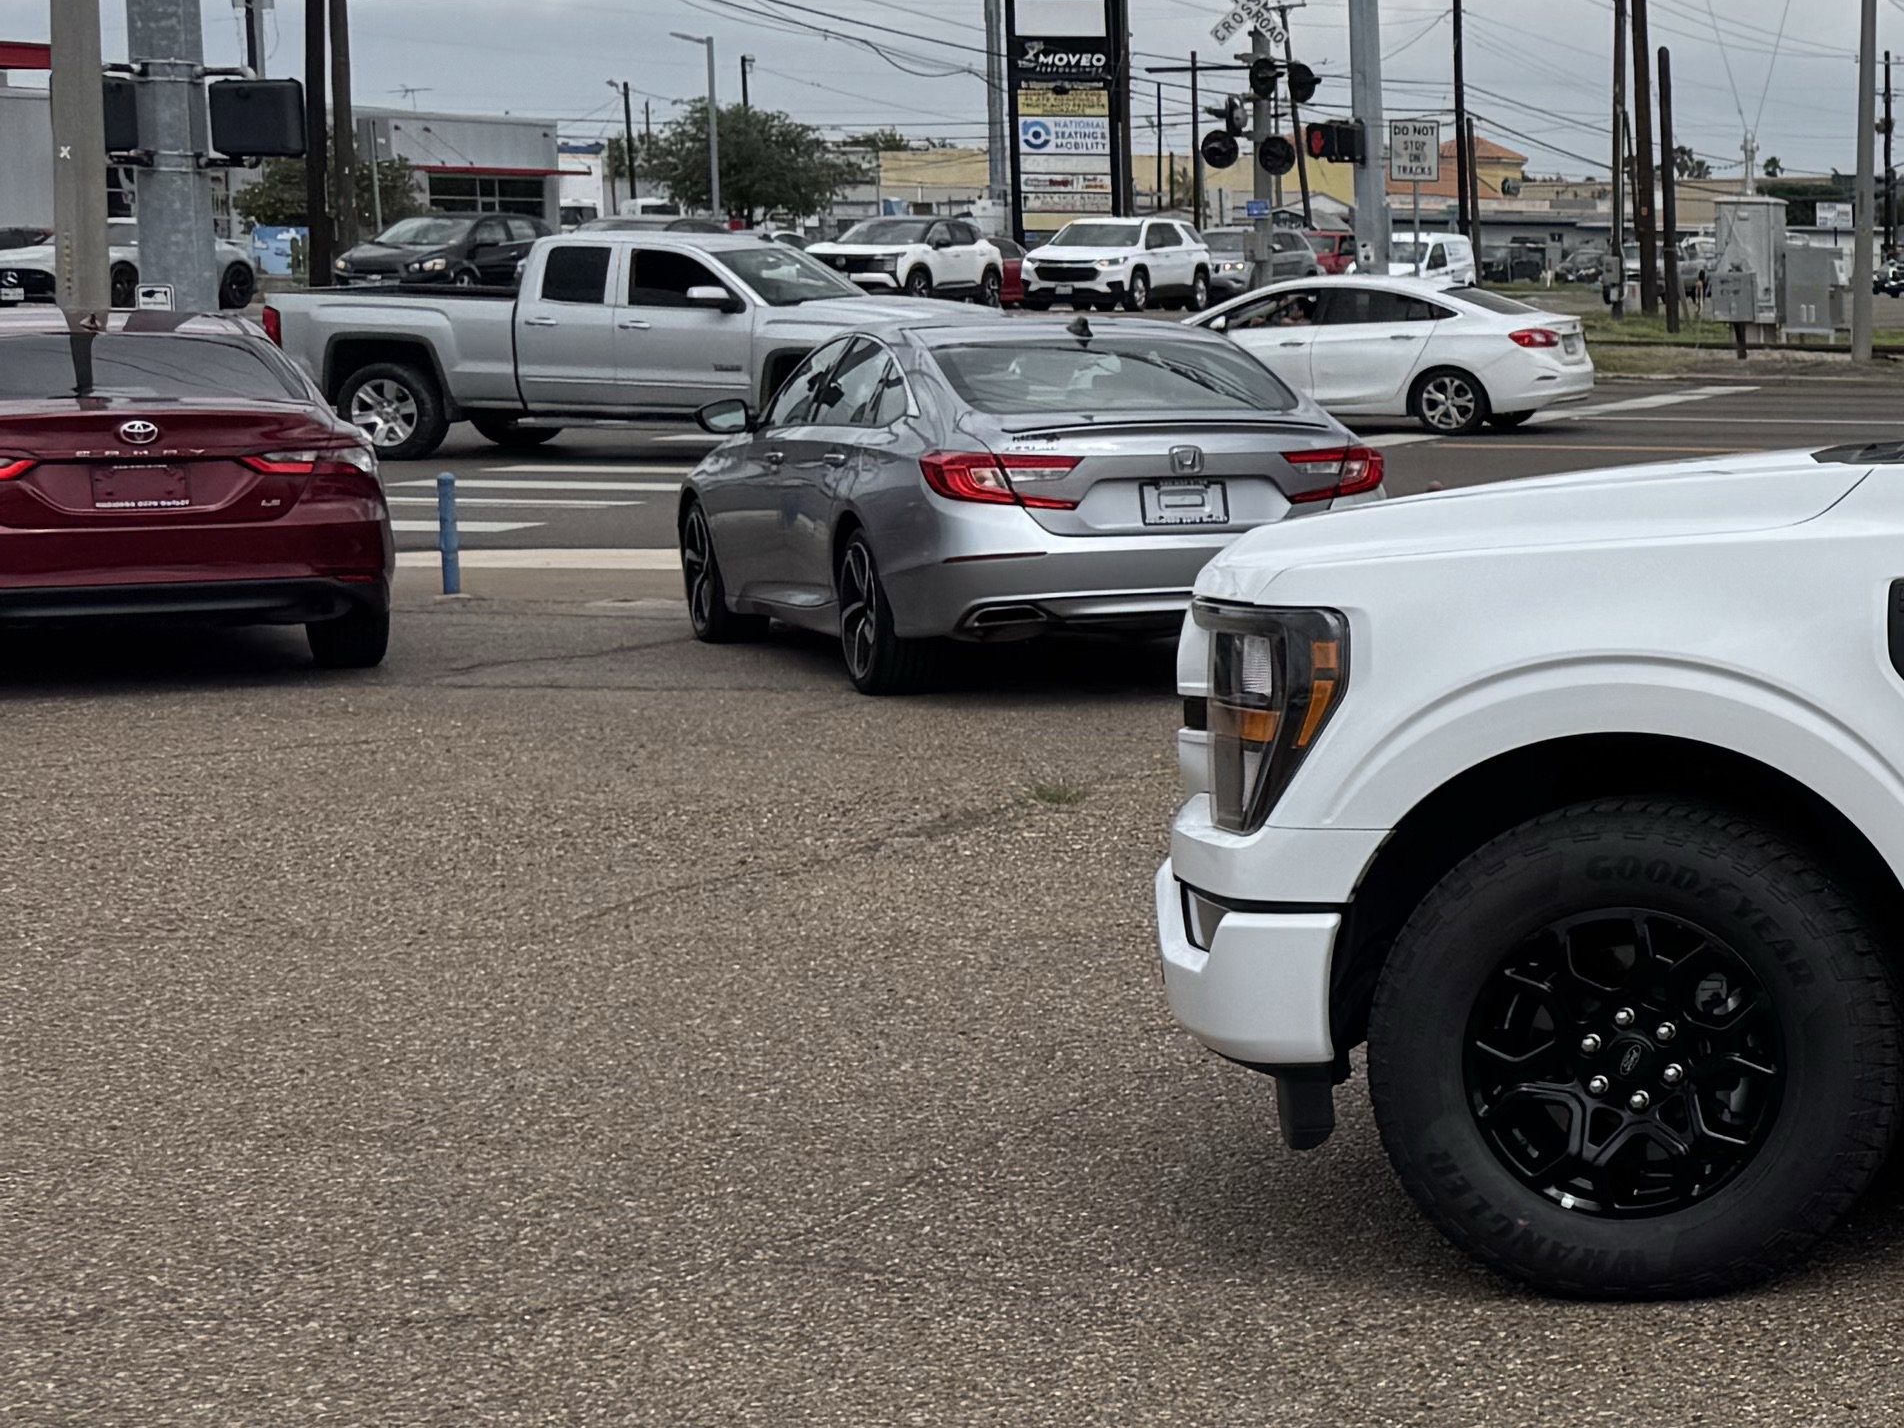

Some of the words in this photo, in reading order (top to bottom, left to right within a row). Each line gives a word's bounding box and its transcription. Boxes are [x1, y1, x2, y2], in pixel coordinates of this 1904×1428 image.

[1251, 9, 1285, 44] ROAD
[1054, 120, 1105, 129] NATIONAL
[1055, 131, 1099, 140] SEATING
[1393, 125, 1409, 136] DO
[1412, 125, 1434, 136] NOT
[1055, 142, 1106, 150] MOBILITY
[1403, 140, 1427, 151] STOP
[1397, 165, 1433, 175] TRACKS
[1584, 853, 1818, 989] GOODYEAR
[1427, 1149, 1648, 1275] WRANGLER
